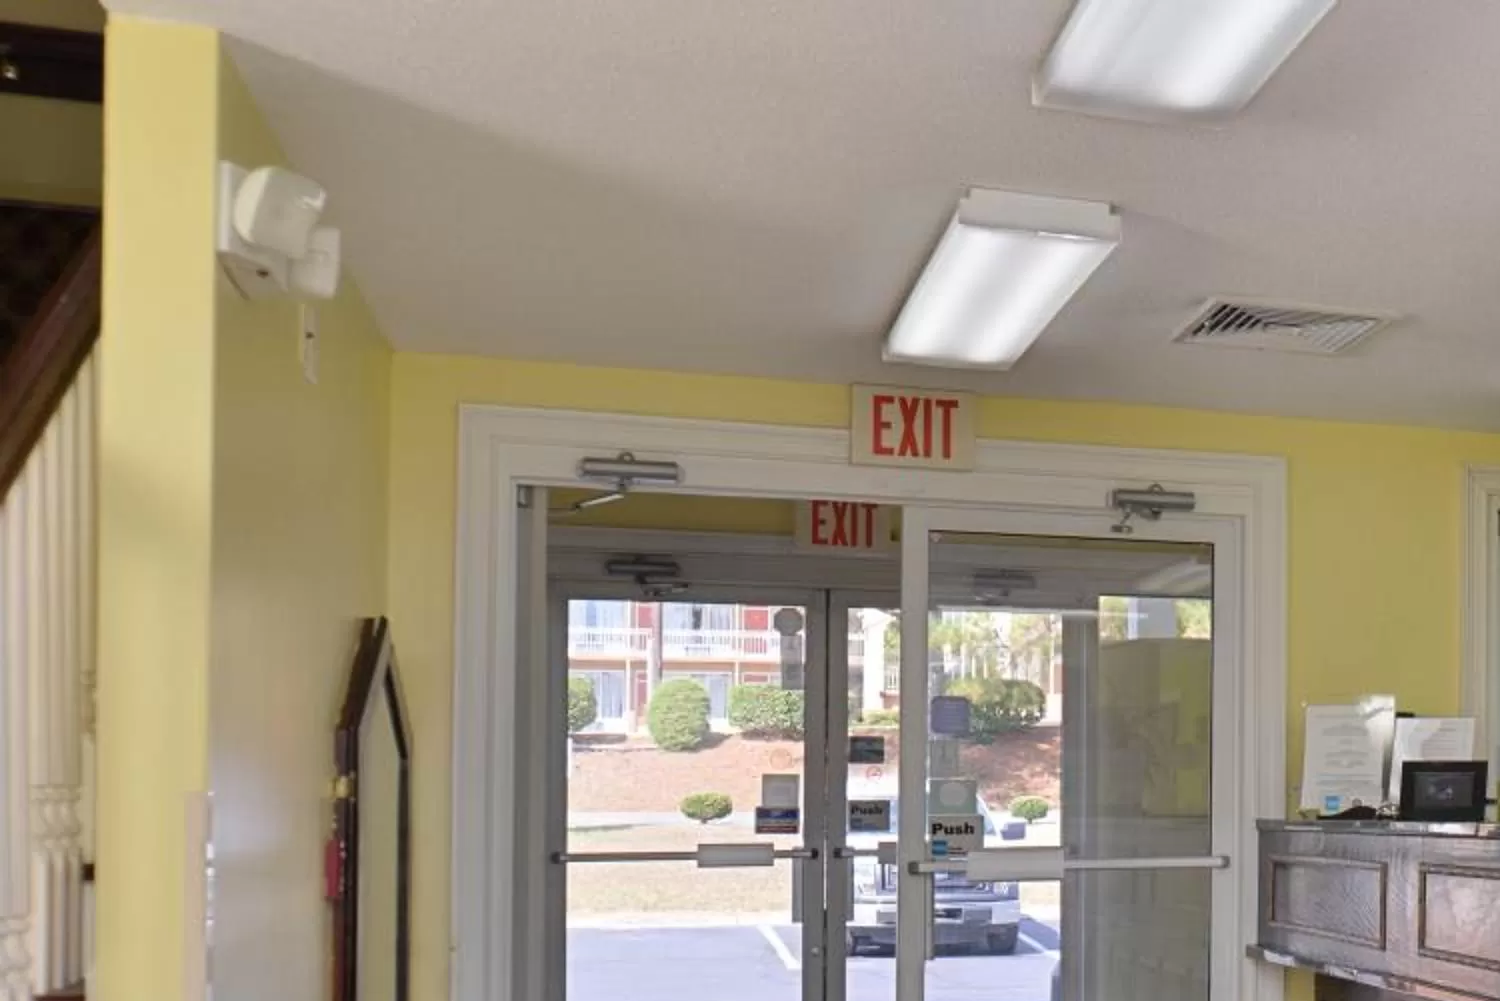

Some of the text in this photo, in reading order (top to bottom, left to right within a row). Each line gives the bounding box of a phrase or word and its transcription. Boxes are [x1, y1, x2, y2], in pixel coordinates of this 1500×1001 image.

[872, 395, 959, 460] EXIT
[811, 500, 878, 548] EXIT
[931, 822, 975, 836] Push
